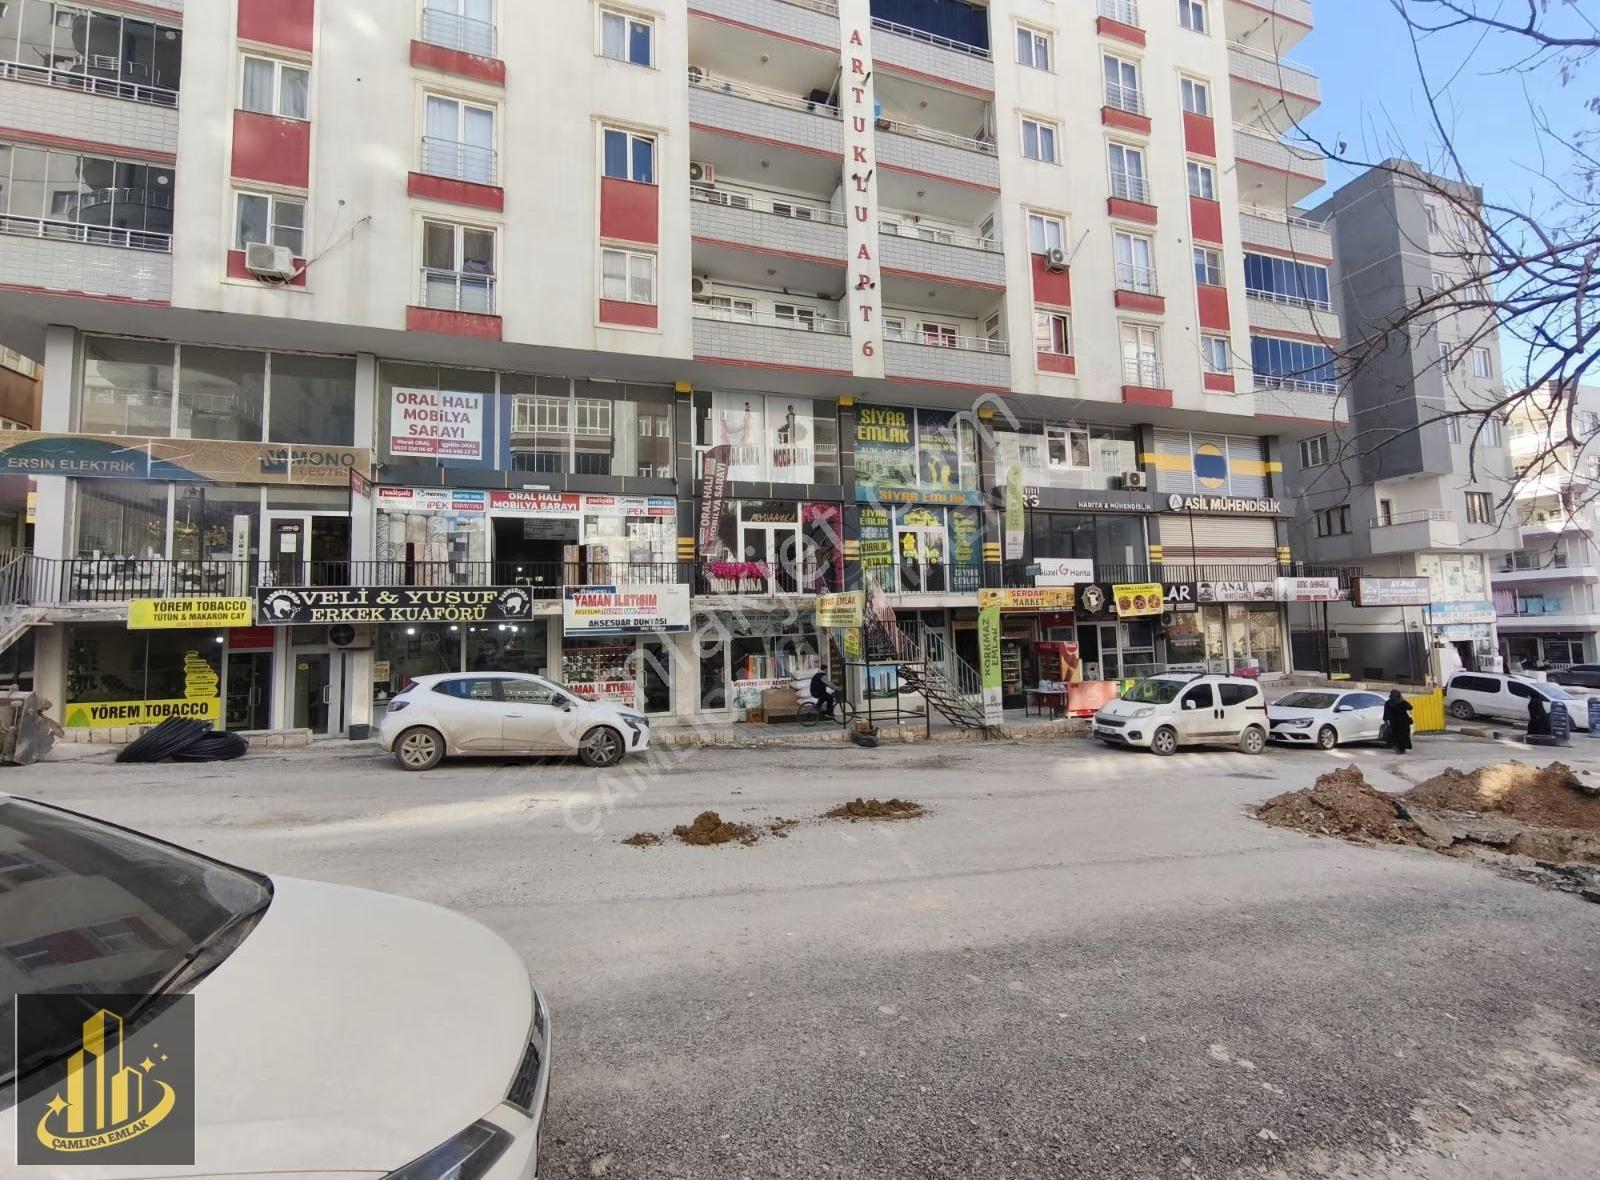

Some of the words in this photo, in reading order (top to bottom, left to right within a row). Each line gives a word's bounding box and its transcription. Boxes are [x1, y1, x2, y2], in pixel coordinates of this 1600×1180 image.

[849, 28, 868, 223] ARTUKLU
[861, 340, 875, 358] 6
[396, 392, 438, 407] ORAL
[442, 396, 479, 410] HALI
[408, 424, 465, 439] SARAYI
[857, 425, 910, 444] EMLAK
[60, 458, 136, 472] ELEKTRİK
[291, 451, 356, 467] MONO
[508, 492, 537, 501] ORAL
[538, 493, 562, 502] HALI
[1184, 494, 1209, 510] ASİL
[1210, 496, 1281, 513] MÜHENDİSLİK
[539, 502, 577, 511] SARAYI
[710, 577, 737, 592] MODA
[738, 578, 763, 592] ANKA
[1220, 582, 1249, 592] ANAR
[298, 588, 369, 606] VELİ
[376, 591, 399, 605] &
[404, 590, 498, 604] YUSUF
[574, 594, 612, 607] YAMAN
[1012, 598, 1045, 606] MARKET
[153, 600, 193, 613] YÖREM
[196, 600, 247, 612] TOBACCO
[310, 607, 386, 623] ERKEK
[389, 604, 488, 621] KUAFÖRÜ
[180, 613, 187, 621] &
[189, 612, 229, 621] MAKARON
[588, 618, 631, 627] AKSESUAR
[982, 618, 992, 677] KORKMAZ
[991, 627, 999, 666] EMLAK
[91, 704, 141, 720] YÖREM
[144, 702, 209, 718] TOBACCO
